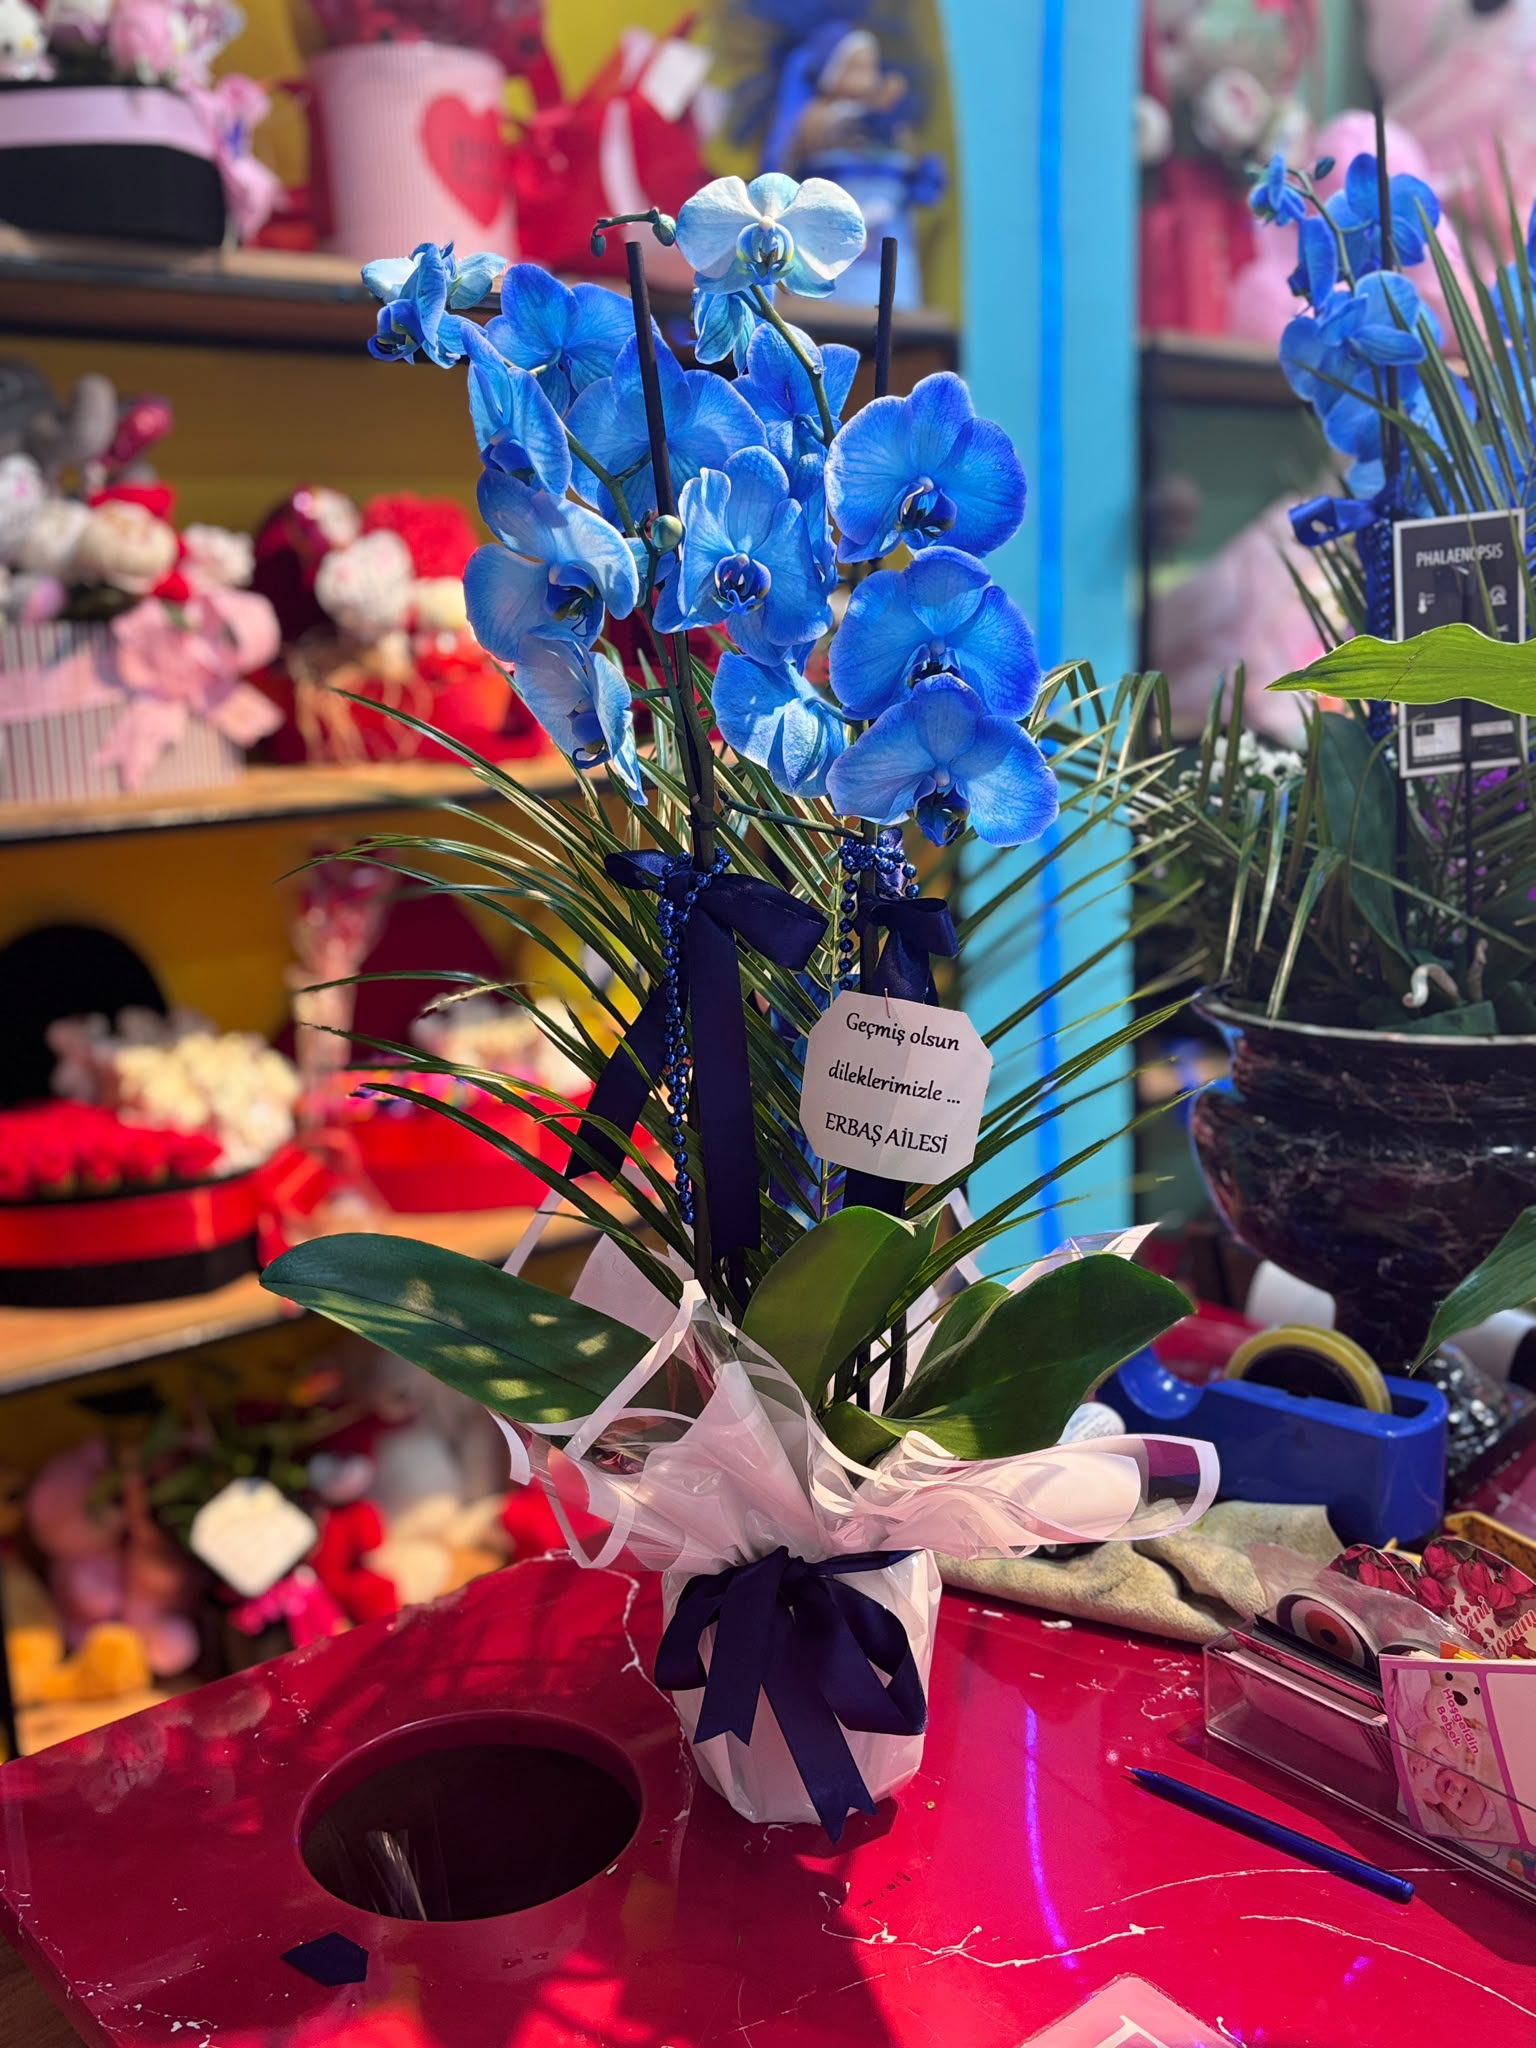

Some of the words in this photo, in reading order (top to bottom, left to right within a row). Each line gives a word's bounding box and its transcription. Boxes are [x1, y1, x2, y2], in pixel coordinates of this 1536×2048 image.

[846, 1012, 905, 1046] Geçmiş
[910, 1025, 960, 1051] olsun
[828, 1059, 943, 1101] dileklerimizle
[825, 1112, 883, 1147] ERBAŞ
[884, 1127, 949, 1154] AİLESİ
[1455, 1595, 1493, 1636] Seni
[1437, 1706, 1460, 1746] Bebek
[1443, 1688, 1479, 1754] Hoşgeldin
